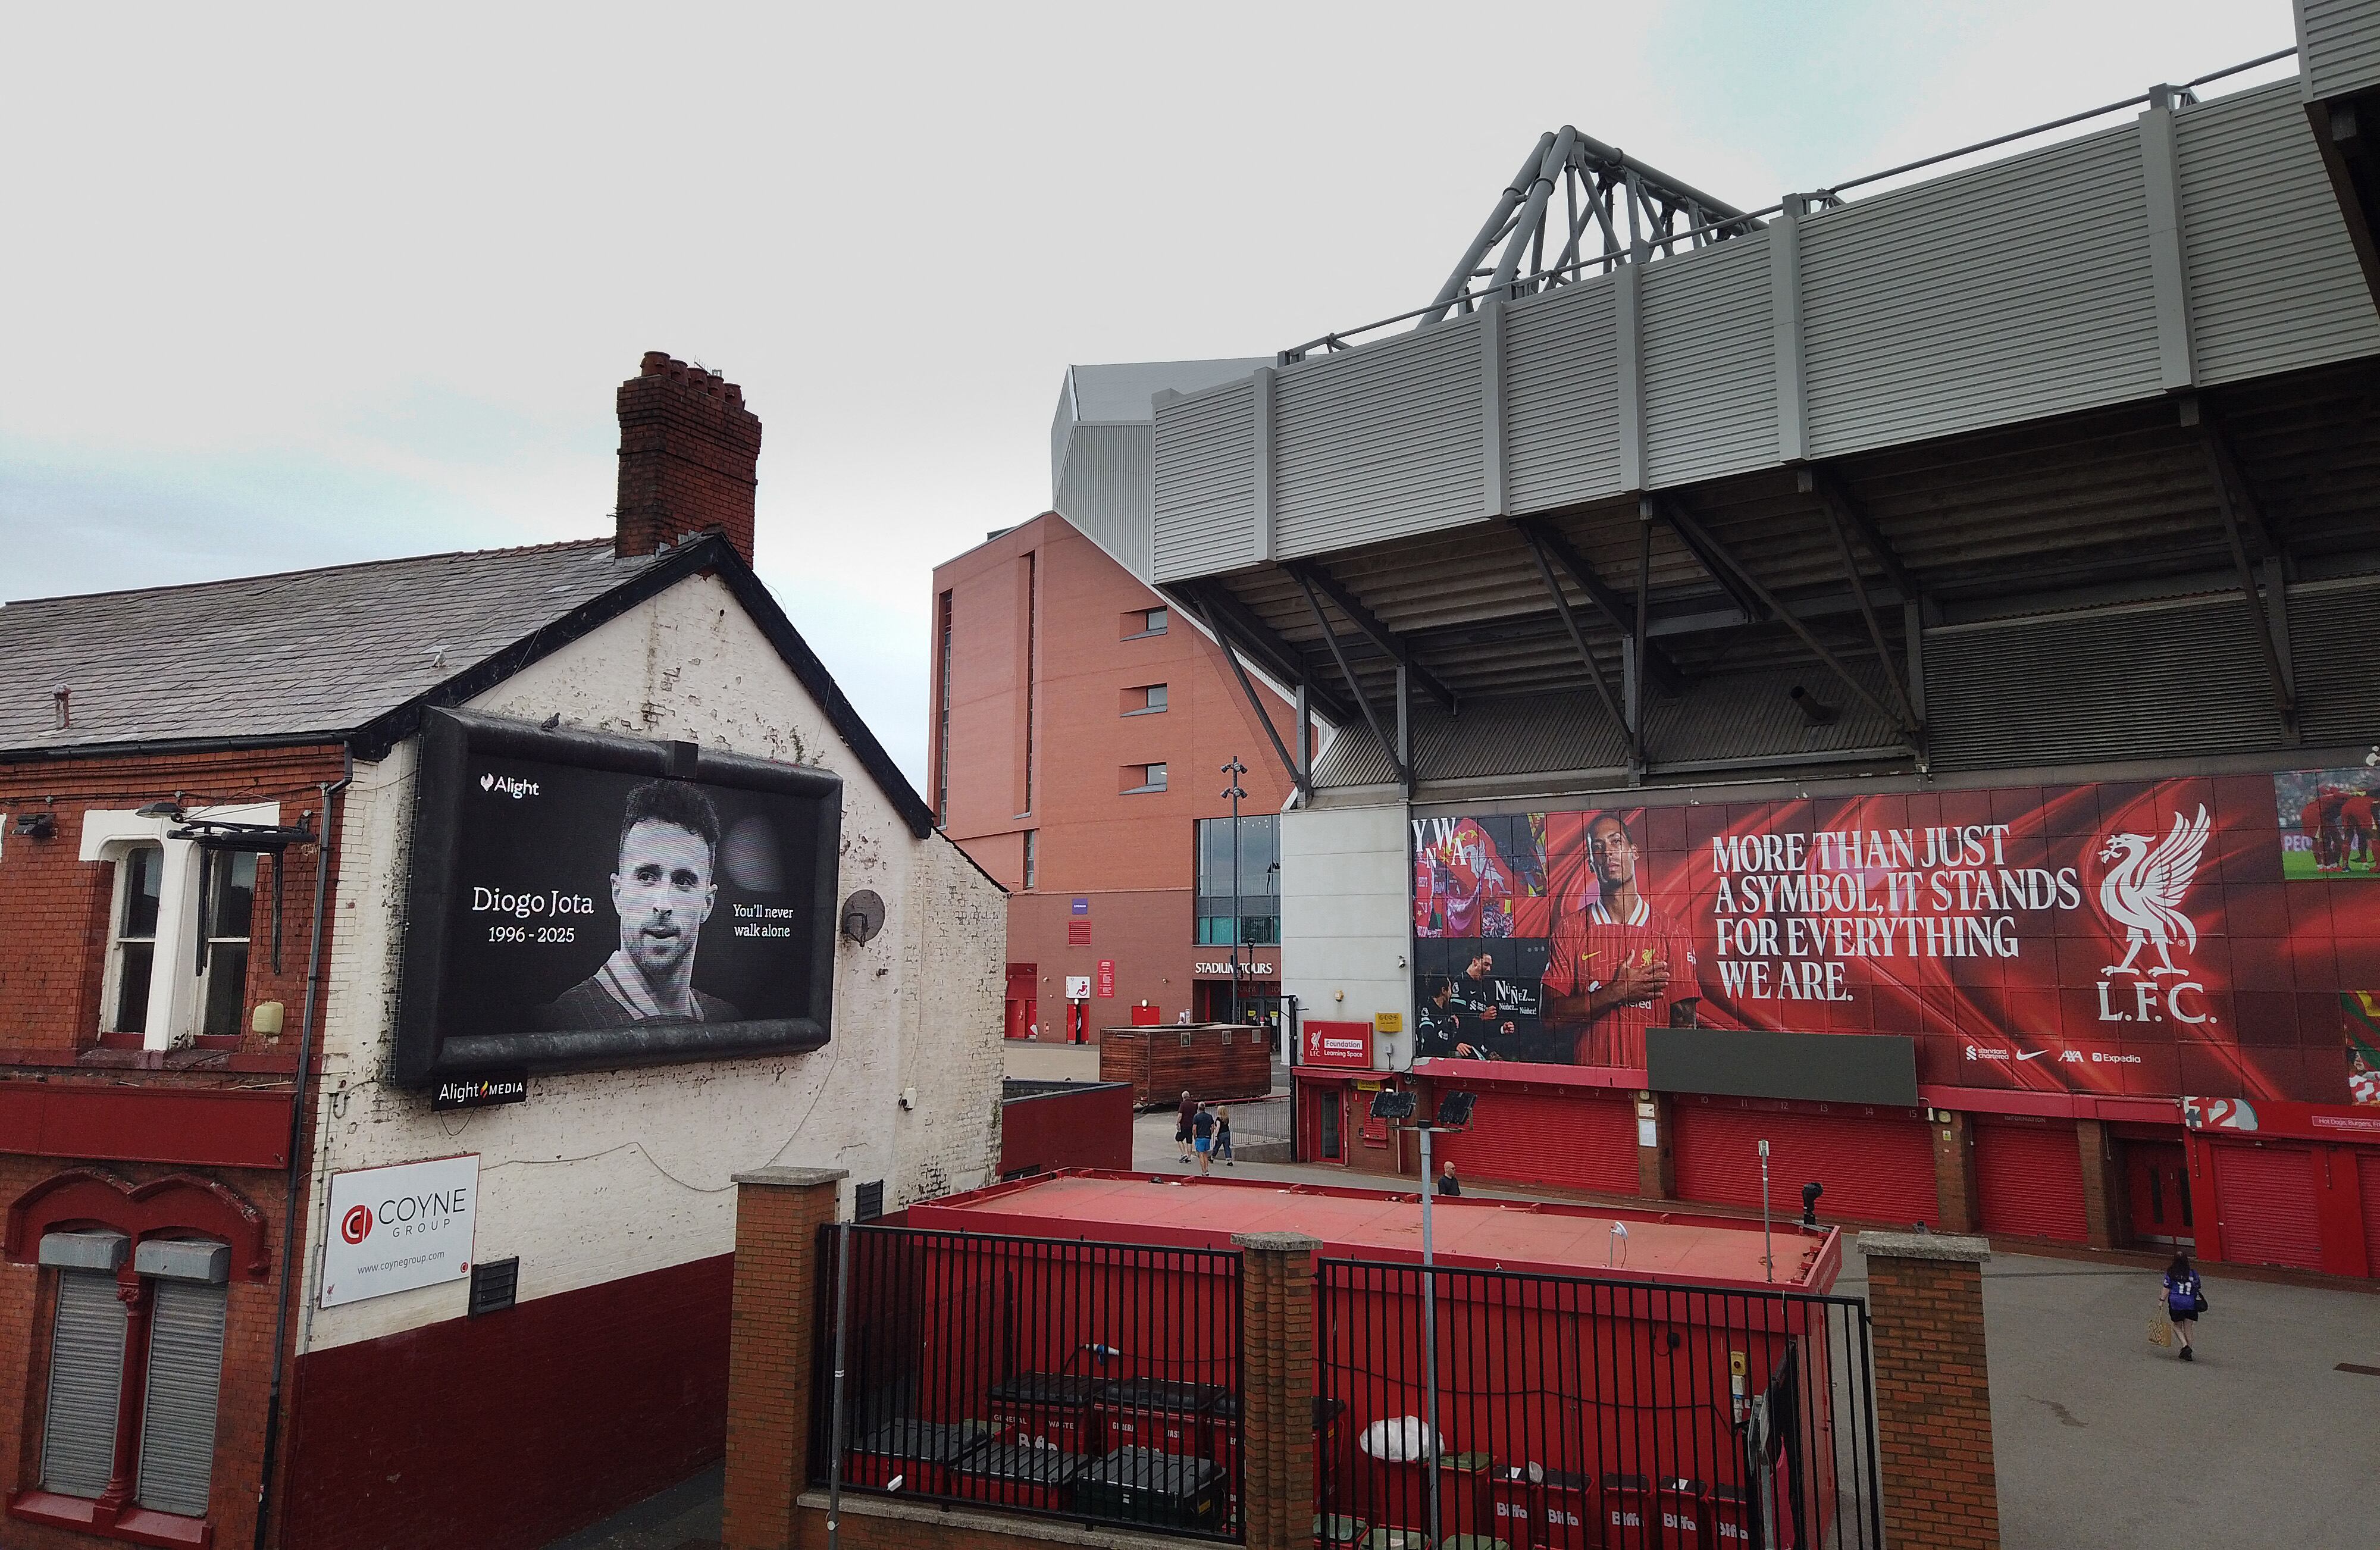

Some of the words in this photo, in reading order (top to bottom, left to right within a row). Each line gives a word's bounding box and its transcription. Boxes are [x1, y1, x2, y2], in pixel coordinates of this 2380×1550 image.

[494, 776, 540, 799] Alight
[1712, 833, 1806, 873] MORE
[1812, 828, 1914, 870] THAN
[1920, 823, 2010, 867] JUST
[1714, 876, 1737, 913] A
[1742, 873, 1884, 916] SYMBOL,
[1889, 872, 1923, 912] IT
[1931, 867, 2081, 911] STANDS
[472, 887, 545, 918] Diogo
[549, 890, 594, 918] Jota
[732, 904, 763, 918] You'll
[764, 908, 794, 919] never
[488, 926, 525, 942] 1996
[537, 927, 575, 942] 2025
[734, 923, 760, 937] walk
[762, 923, 791, 937] alone
[1717, 918, 1782, 956] FOR
[1787, 915, 2019, 958] EVERYTHING
[1240, 963, 1273, 974] TOURS
[1717, 962, 1772, 1000] WE
[1777, 962, 1854, 1002] ARE.
[2096, 981, 2218, 1024] L.F.C.
[1326, 1040, 1361, 1048] Foundation
[1324, 1050, 1346, 1058] Learning
[2058, 1050, 2084, 1063] AXA
[2103, 1054, 2141, 1063] Expedia
[439, 1081, 479, 1103] Alight
[488, 1082, 523, 1095] MEDIA
[1781, 1101, 1789, 1110] 12
[1820, 1104, 1828, 1112] 13
[1865, 1107, 1874, 1116] 14
[1909, 1110, 1917, 1118] 15
[378, 1188, 466, 1225] COYNE
[392, 1219, 450, 1238] GROUP
[357, 1250, 444, 1275] www.coynegroup.com
[1048, 1420, 1074, 1429] WATE
